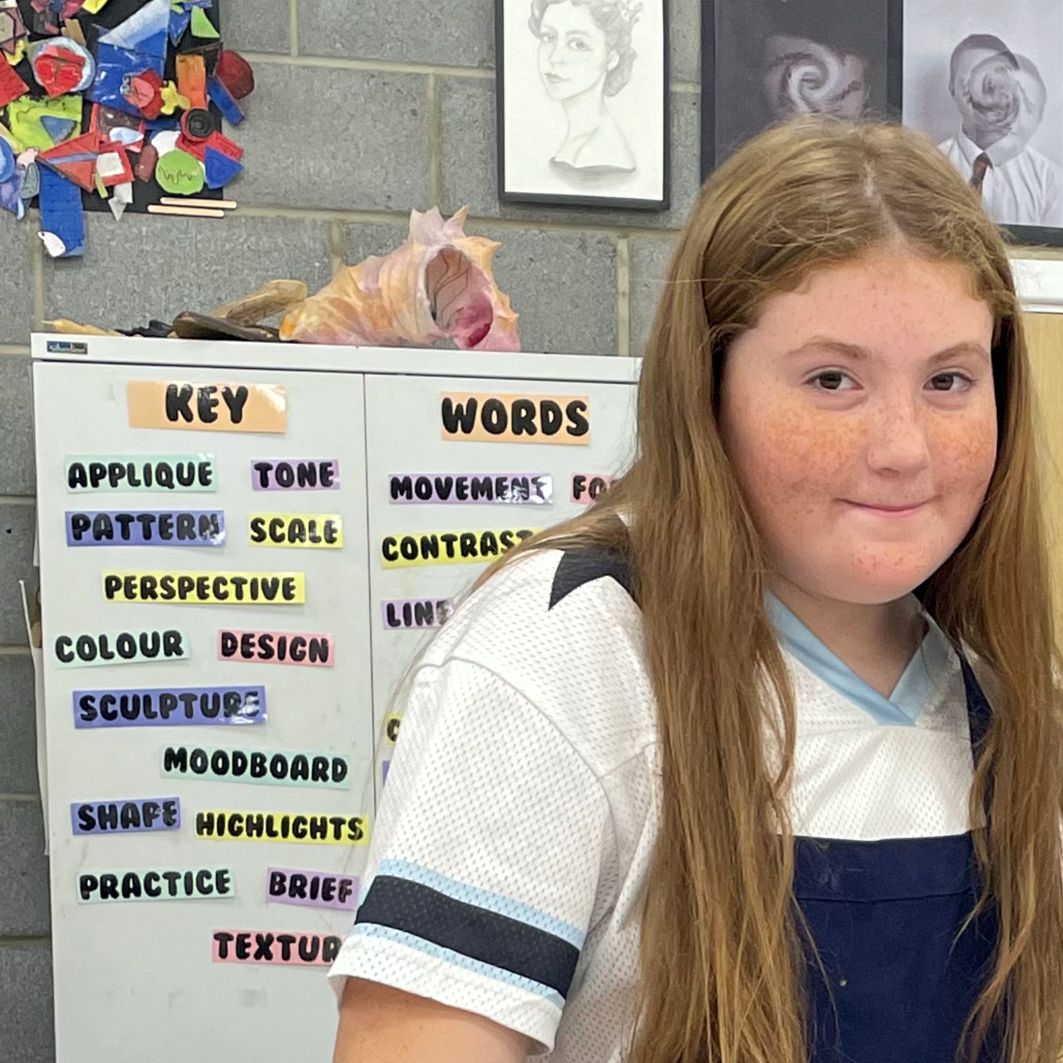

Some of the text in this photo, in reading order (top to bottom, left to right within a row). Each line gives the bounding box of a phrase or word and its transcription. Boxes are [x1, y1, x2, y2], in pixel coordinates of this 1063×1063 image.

[165, 383, 590, 437] KEY WORDS
[67, 461, 213, 490] APPLIQUE
[253, 461, 335, 489] TONE
[389, 475, 548, 501] MOVEMENT
[70, 512, 221, 541] PATTERN
[250, 516, 339, 544] SCALE
[104, 574, 297, 601] PERSPECTIVE
[55, 629, 185, 663] COLOUR
[220, 631, 330, 663] DESIGN
[78, 691, 260, 722] SCULPTURE
[163, 746, 349, 783] MOODBOARD
[77, 800, 178, 831] SHAPE
[195, 812, 364, 841] HIGHLIGHTS
[79, 868, 231, 900] PRACTICE
[268, 871, 354, 903] BRIEF
[212, 932, 342, 963] TEXTUR
